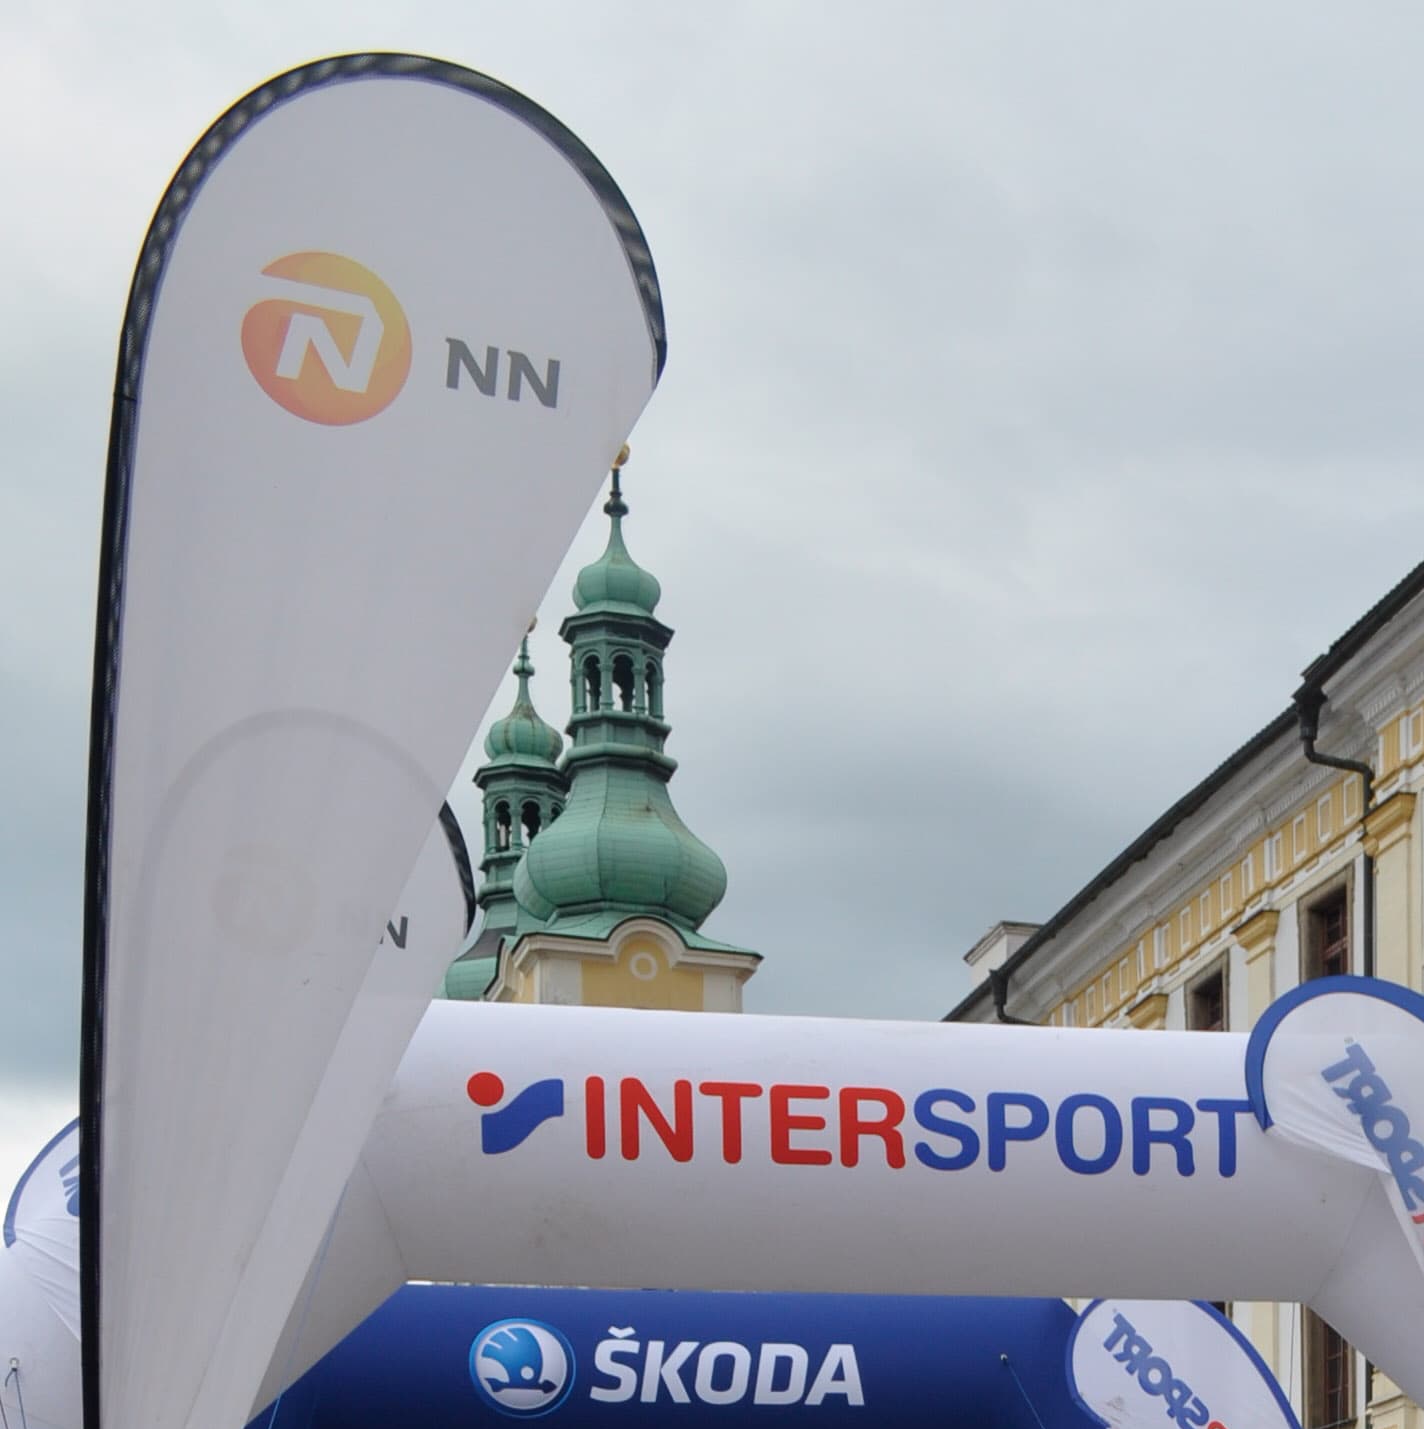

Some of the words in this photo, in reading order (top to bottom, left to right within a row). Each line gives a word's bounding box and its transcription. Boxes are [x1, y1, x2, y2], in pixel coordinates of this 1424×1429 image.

[446, 338, 561, 409] NN
[586, 1075, 1255, 1178] INTERSPORT
[590, 1327, 865, 1406] ŠKODA
